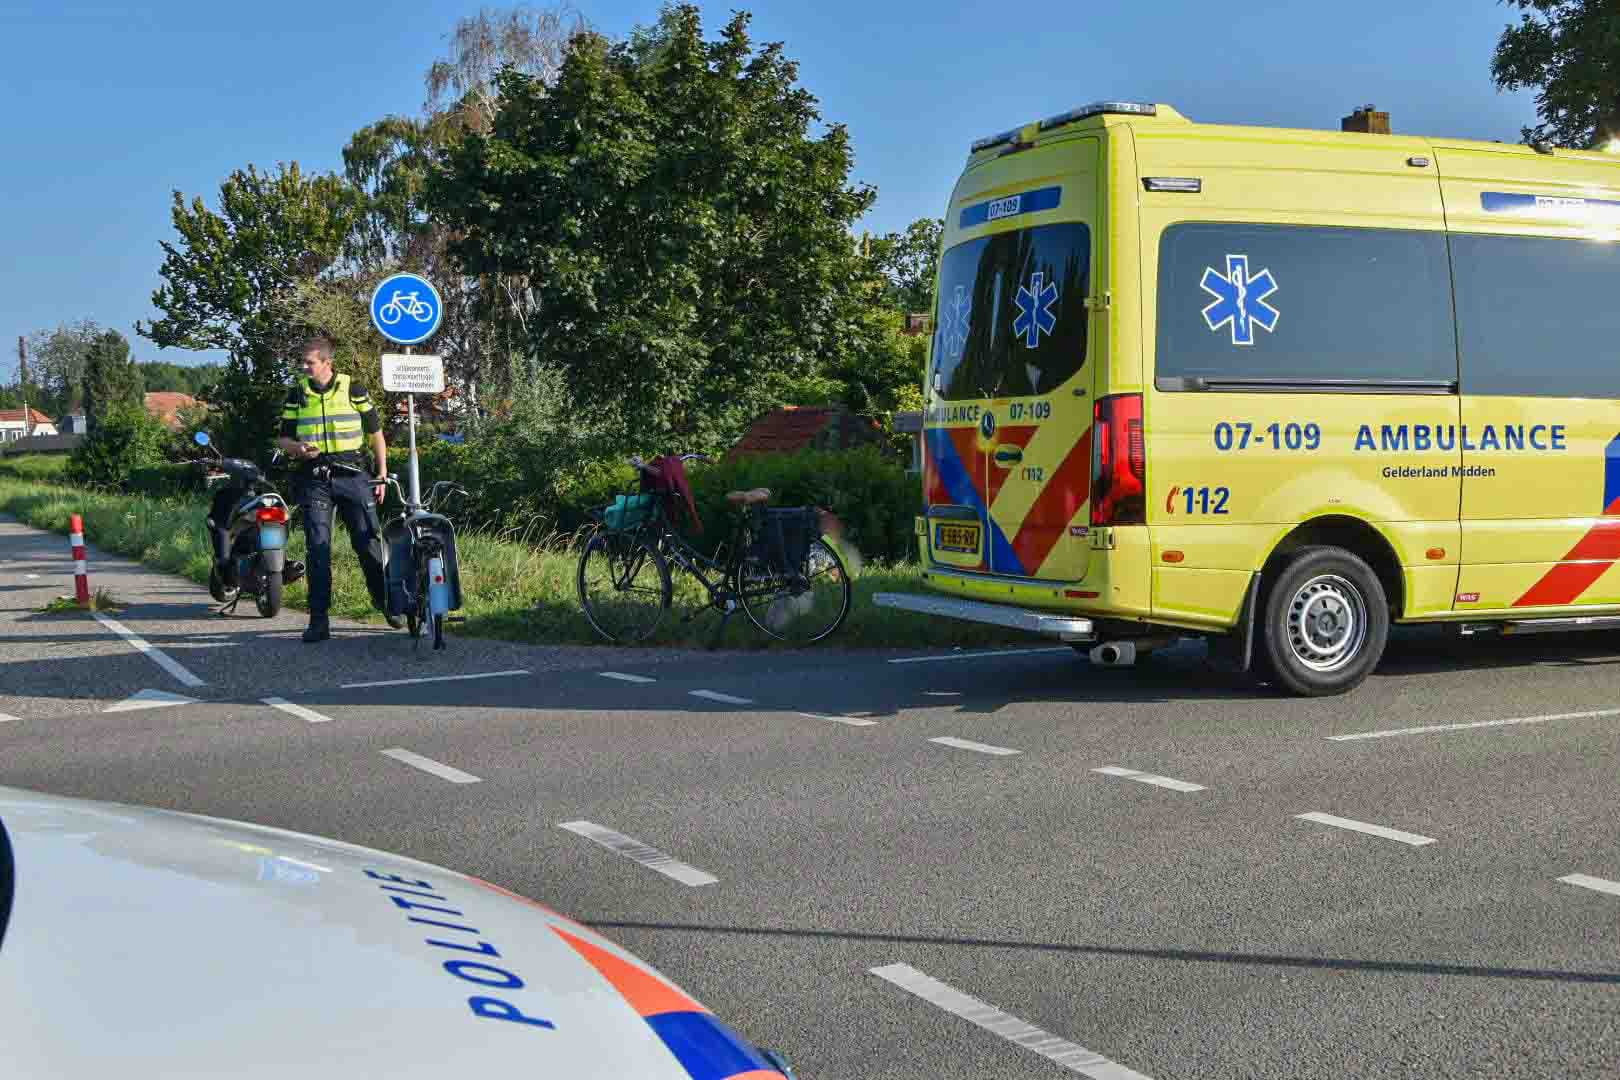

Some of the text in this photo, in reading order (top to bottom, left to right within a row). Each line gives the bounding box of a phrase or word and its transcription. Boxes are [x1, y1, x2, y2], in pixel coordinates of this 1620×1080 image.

[991, 197, 1018, 218] 07-109
[1009, 401, 1051, 420] 07-109
[1213, 421, 1322, 451] 07-109
[1353, 423, 1567, 451] AMBULANCE
[1382, 465, 1496, 478] Gelderland Midden
[362, 868, 557, 1030] POLITIE
